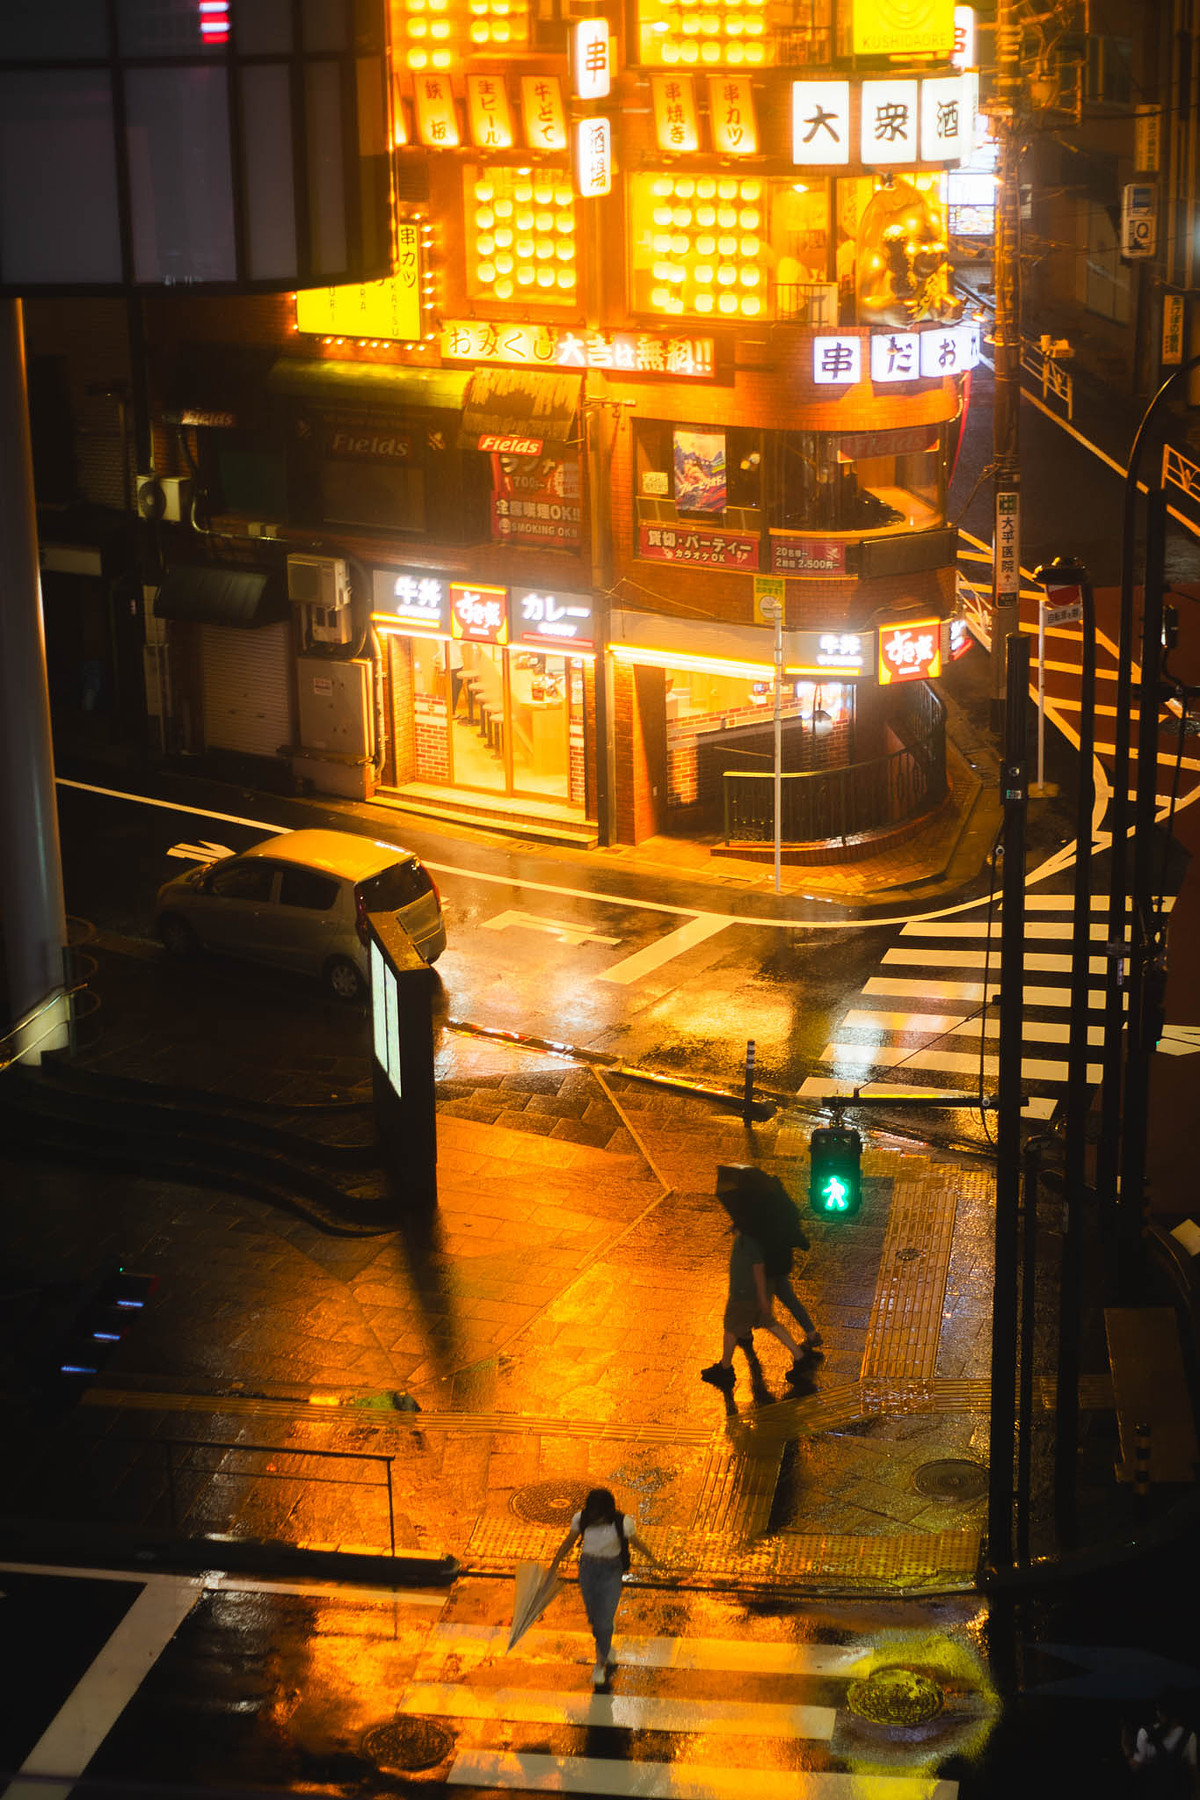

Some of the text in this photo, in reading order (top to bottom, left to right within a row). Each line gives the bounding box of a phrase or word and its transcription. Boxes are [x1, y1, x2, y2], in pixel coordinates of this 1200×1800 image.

[585, 36, 607, 83] 串
[862, 32, 947, 49] KUSHIDAORE
[478, 80, 501, 144] 生ビール
[533, 83, 554, 142] 牛どて
[665, 81, 686, 145] 串焼き
[723, 83, 744, 147] 串カツ
[802, 99, 978, 143] 大衆酒
[400, 226, 417, 288] 串カツ
[332, 434, 409, 457] Fields
[482, 437, 540, 454] Fields
[511, 521, 556, 536] SMOKING
[1001, 516, 1015, 574] 大平医院
[394, 575, 442, 608] 牛丼
[455, 591, 501, 629] すき家
[520, 592, 591, 622] カレー
[885, 630, 934, 666] すき家
